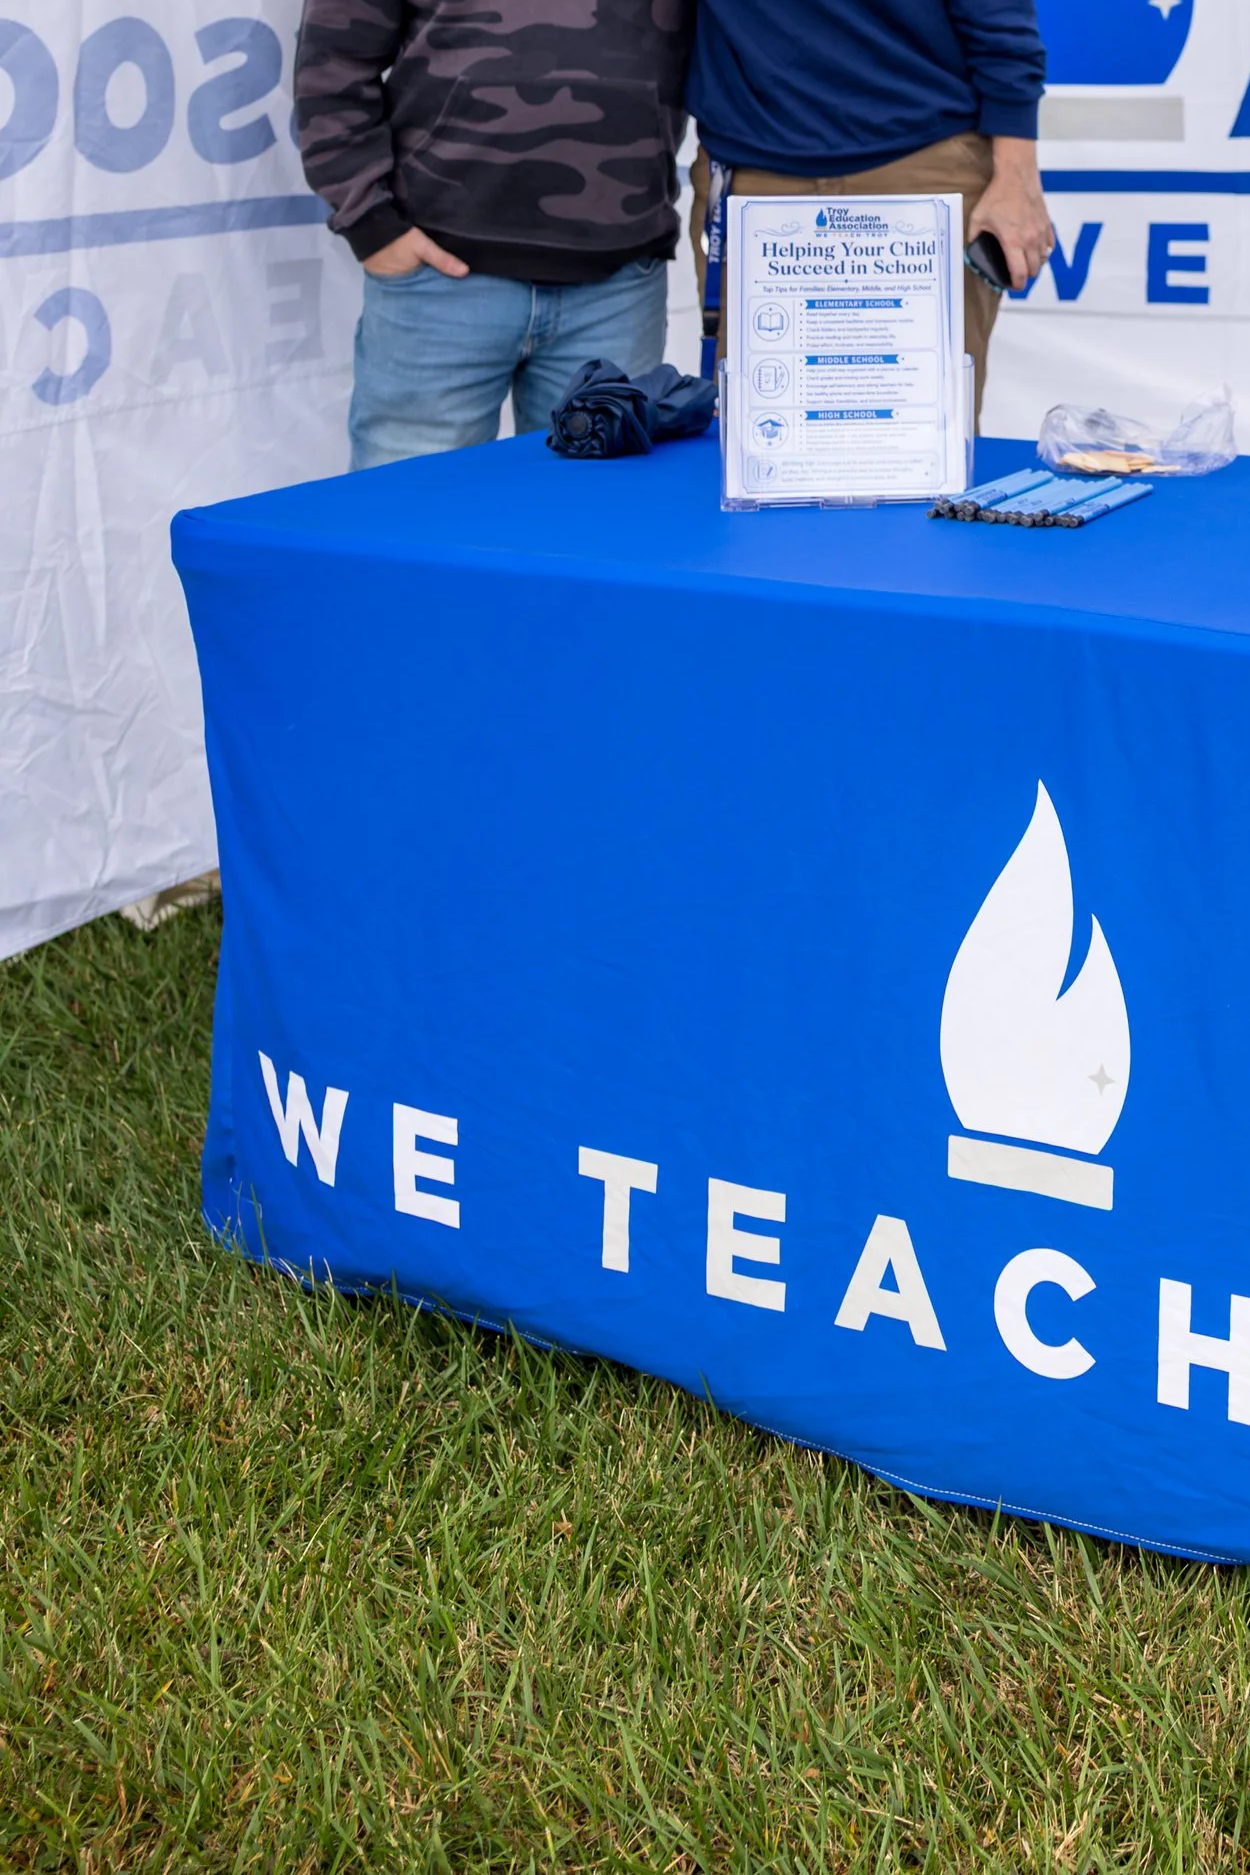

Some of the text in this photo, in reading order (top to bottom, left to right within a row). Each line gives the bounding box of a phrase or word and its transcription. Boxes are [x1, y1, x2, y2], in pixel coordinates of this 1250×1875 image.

[827, 207, 849, 216] Troy
[829, 215, 881, 223] Education
[829, 222, 889, 230] Association
[709, 223, 722, 264] TROY
[762, 240, 936, 261] Helping Your Child
[768, 259, 933, 276] Succeed in School
[815, 299, 895, 308] ELEMENTARY SCHOOL
[818, 356, 884, 364] MIDDLE SCHOOL
[843, 411, 877, 419] SCHOOL
[258, 1050, 460, 1229] WE
